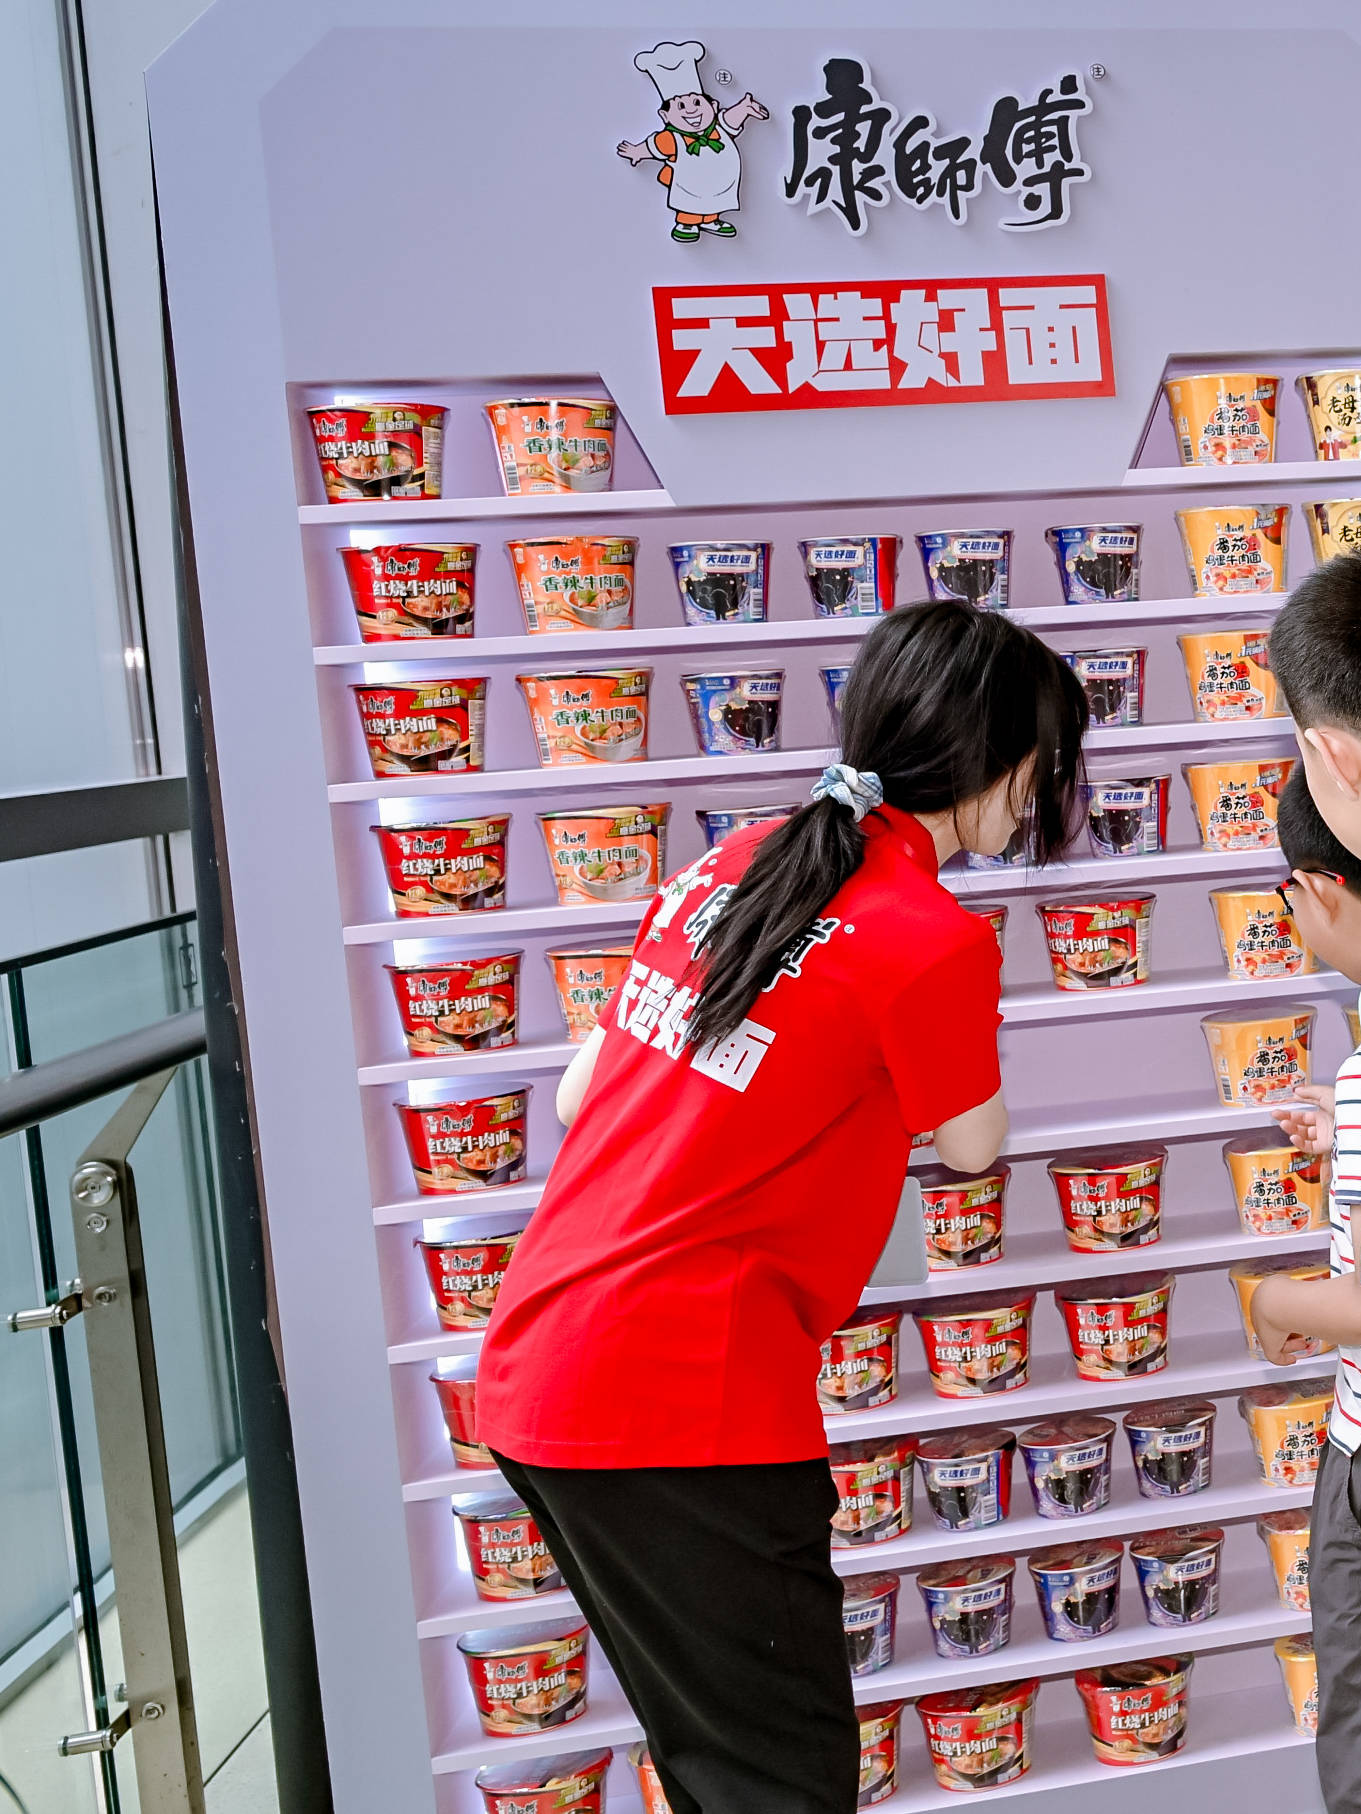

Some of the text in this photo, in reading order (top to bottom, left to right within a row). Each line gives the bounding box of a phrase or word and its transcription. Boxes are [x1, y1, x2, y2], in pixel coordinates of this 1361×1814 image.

[784, 58, 1086, 231] 康師傅
[671, 284, 1103, 398] 天选好面
[1215, 405, 1249, 422] 番茄
[525, 438, 608, 454] 香辣牛肉面
[958, 539, 1003, 555] 天选好面
[1215, 536, 1249, 553] 番茄
[705, 553, 750, 566] 天选好面
[814, 549, 857, 562] 天选好面
[1204, 554, 1262, 566] 鸡蛋牛肉面
[372, 579, 458, 597] 红烧牛肉面
[542, 575, 625, 592] 香辣牛肉面
[1087, 660, 1129, 673] 天选好面
[1205, 663, 1236, 680] 番茄
[1198, 680, 1251, 693] 鸡蛋牛肉面
[363, 715, 437, 735] 红烧牛肉面
[552, 707, 638, 727] 香辣牛肉面
[1102, 790, 1144, 804] 天选好面
[1218, 794, 1250, 811] 番茄
[1208, 811, 1265, 824] 鸡蛋牛肉面
[556, 846, 639, 865] 香辣牛肉面
[401, 854, 485, 875] 红烧牛肉面
[1246, 922, 1278, 940] 番茄
[1235, 938, 1292, 952] 鸡蛋牛肉面
[408, 995, 491, 1017] 红烧牛肉面
[1255, 1049, 1287, 1067] 番茄
[1243, 1063, 1299, 1079] 鸡蛋牛肉面
[427, 1130, 511, 1153] 红烧牛肉面
[1252, 1180, 1284, 1197] 番茄
[1070, 1197, 1142, 1217] 红烧牛肉面
[1078, 1324, 1149, 1345] 红烧牛肉面
[934, 1339, 1007, 1361] 红烧牛肉面
[1162, 1432, 1202, 1449] 天选好面
[1285, 1433, 1317, 1449] 番茄
[1066, 1448, 1104, 1465] 天选好面
[937, 1466, 981, 1482] 天选好面
[1174, 1560, 1214, 1578] 天选好面
[961, 1588, 1003, 1606] 天选好面
[485, 1671, 566, 1699] 红烧牛肉面
[1110, 1704, 1180, 1731] 红烧牛肉面
[931, 1737, 998, 1758] 红烧牛肉面
